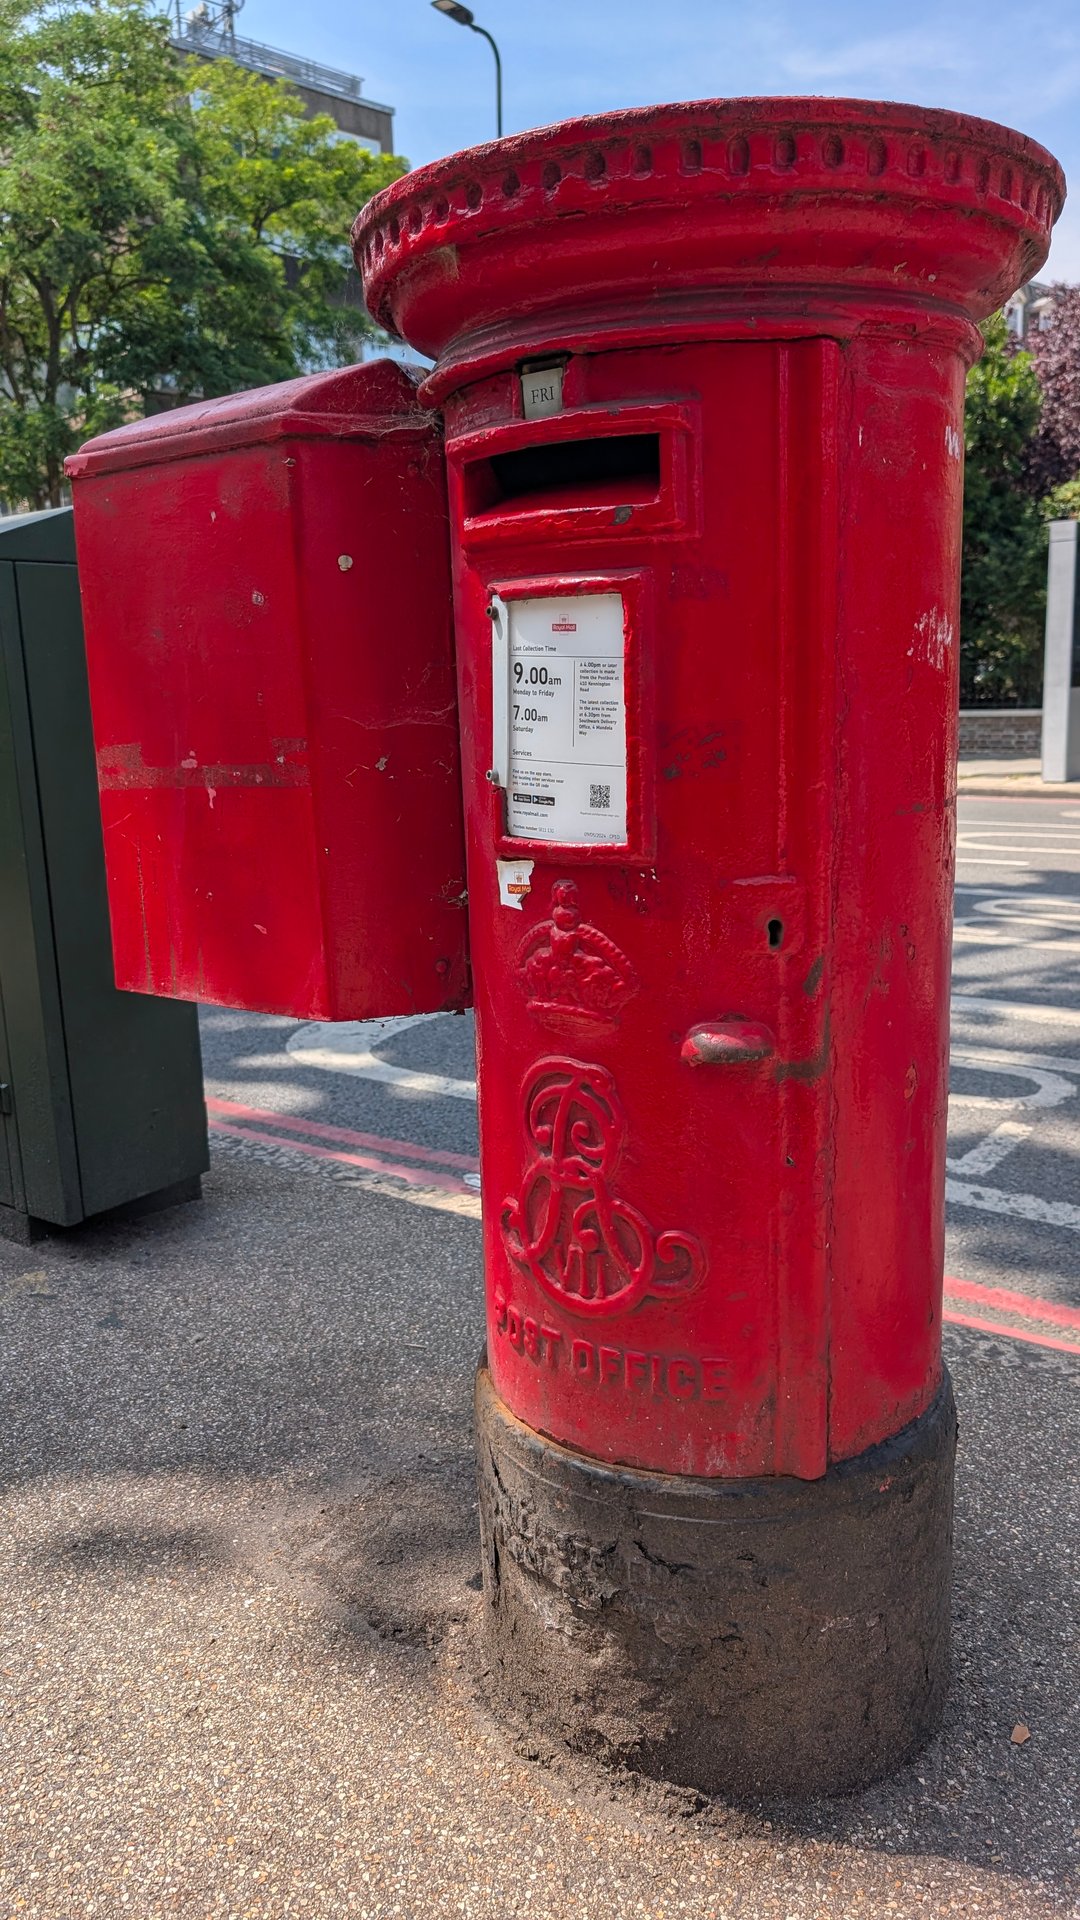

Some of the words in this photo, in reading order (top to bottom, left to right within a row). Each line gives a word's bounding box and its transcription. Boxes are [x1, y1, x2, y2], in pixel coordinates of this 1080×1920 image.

[531, 386, 554, 404] FRI
[514, 662, 562, 685] 9.00am
[513, 688, 531, 696] Monday
[538, 690, 554, 698] Friday
[513, 705, 548, 722] 7.00am
[513, 725, 533, 733] Saturday
[495, 1295, 560, 1373] POST
[571, 1338, 732, 1400] OFFICE
